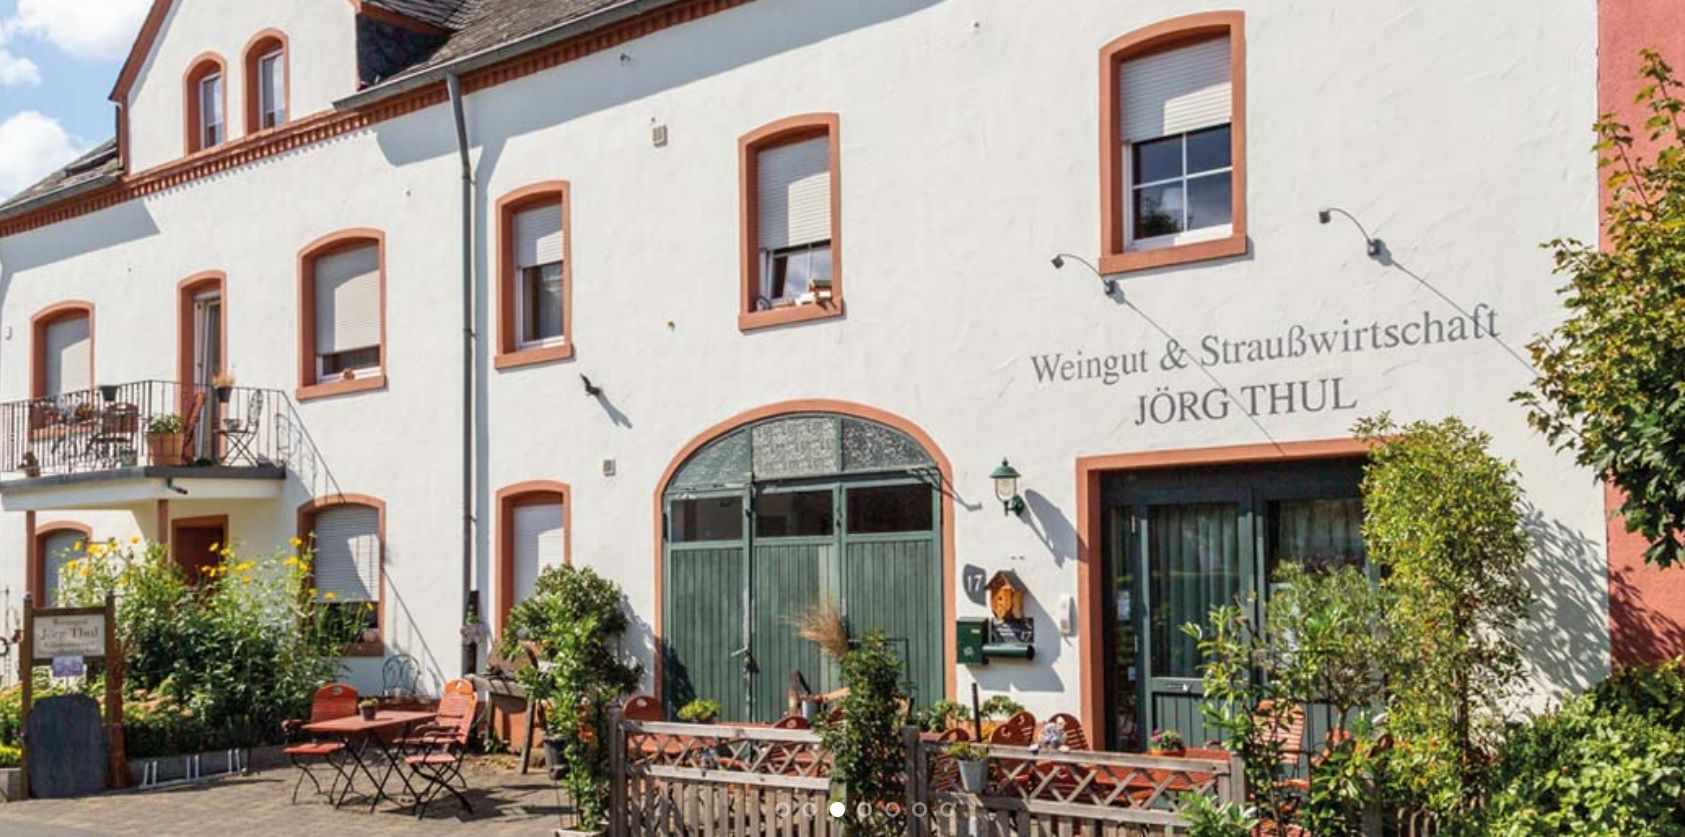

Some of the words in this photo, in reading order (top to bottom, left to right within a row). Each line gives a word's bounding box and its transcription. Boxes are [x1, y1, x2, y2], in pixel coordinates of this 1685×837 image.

[1030, 348, 1150, 386] Weingut
[1159, 338, 1188, 372] &
[1200, 302, 1501, 368] Straußwirtschaft
[1134, 386, 1230, 426] JÖRG
[1240, 377, 1359, 417] THUL
[966, 574, 984, 592] 17
